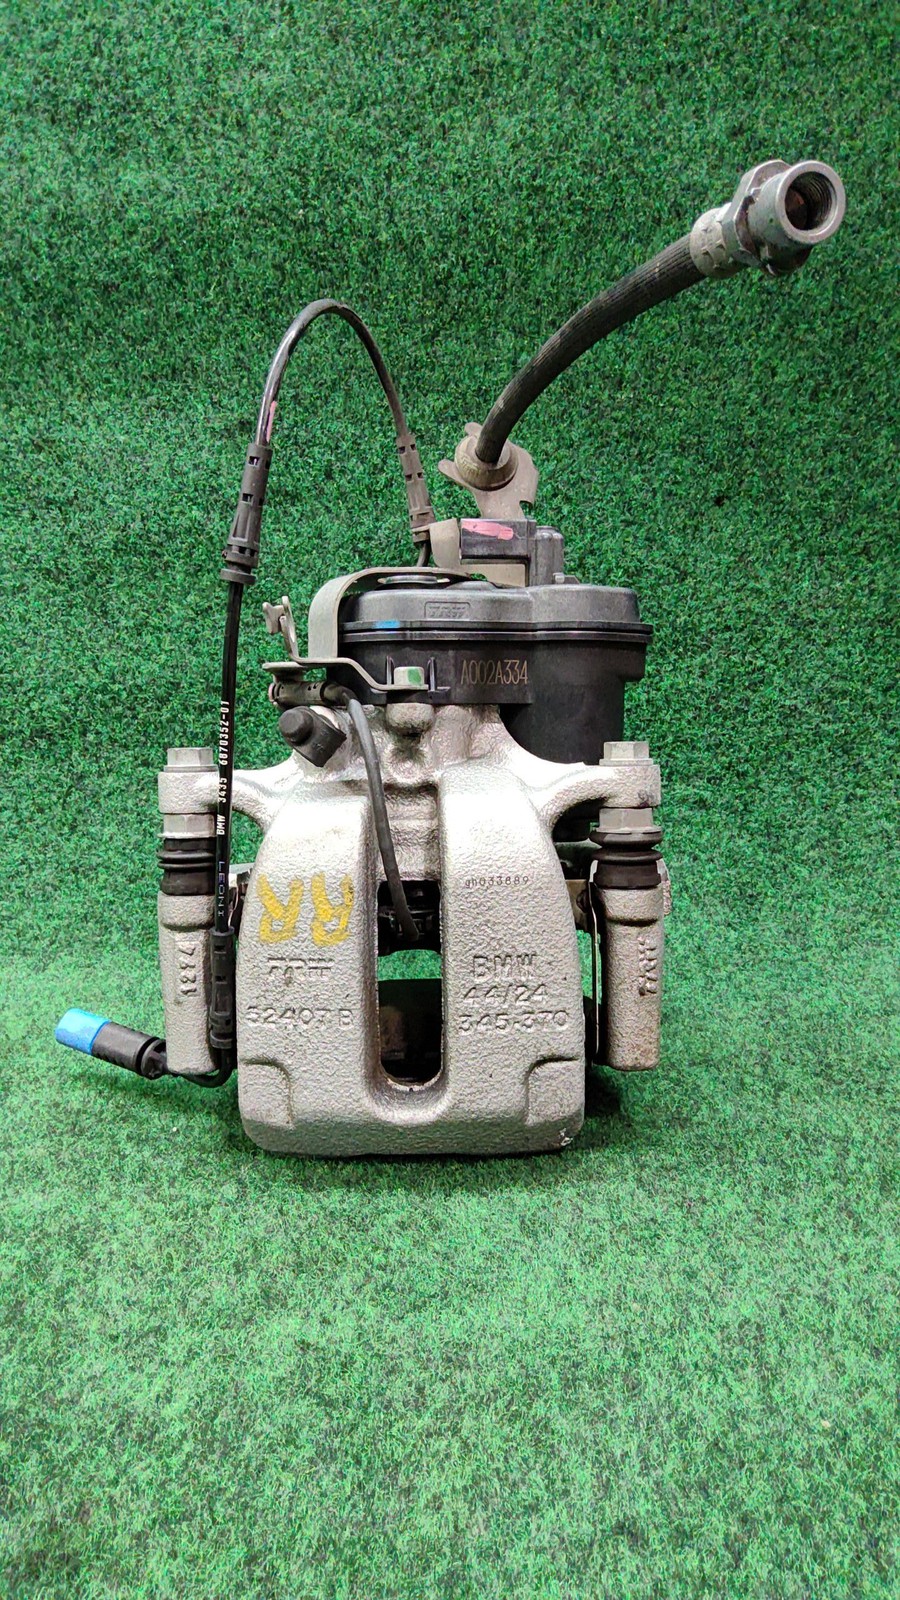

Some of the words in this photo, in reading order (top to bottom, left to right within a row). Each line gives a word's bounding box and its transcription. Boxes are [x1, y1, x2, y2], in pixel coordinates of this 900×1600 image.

[460, 659, 528, 685] A002A334
[219, 700, 231, 766] 6870352-01
[218, 777, 228, 804] 3435
[216, 814, 227, 836] BMW
[471, 953, 538, 980] BMW
[463, 983, 548, 1004] 44/24
